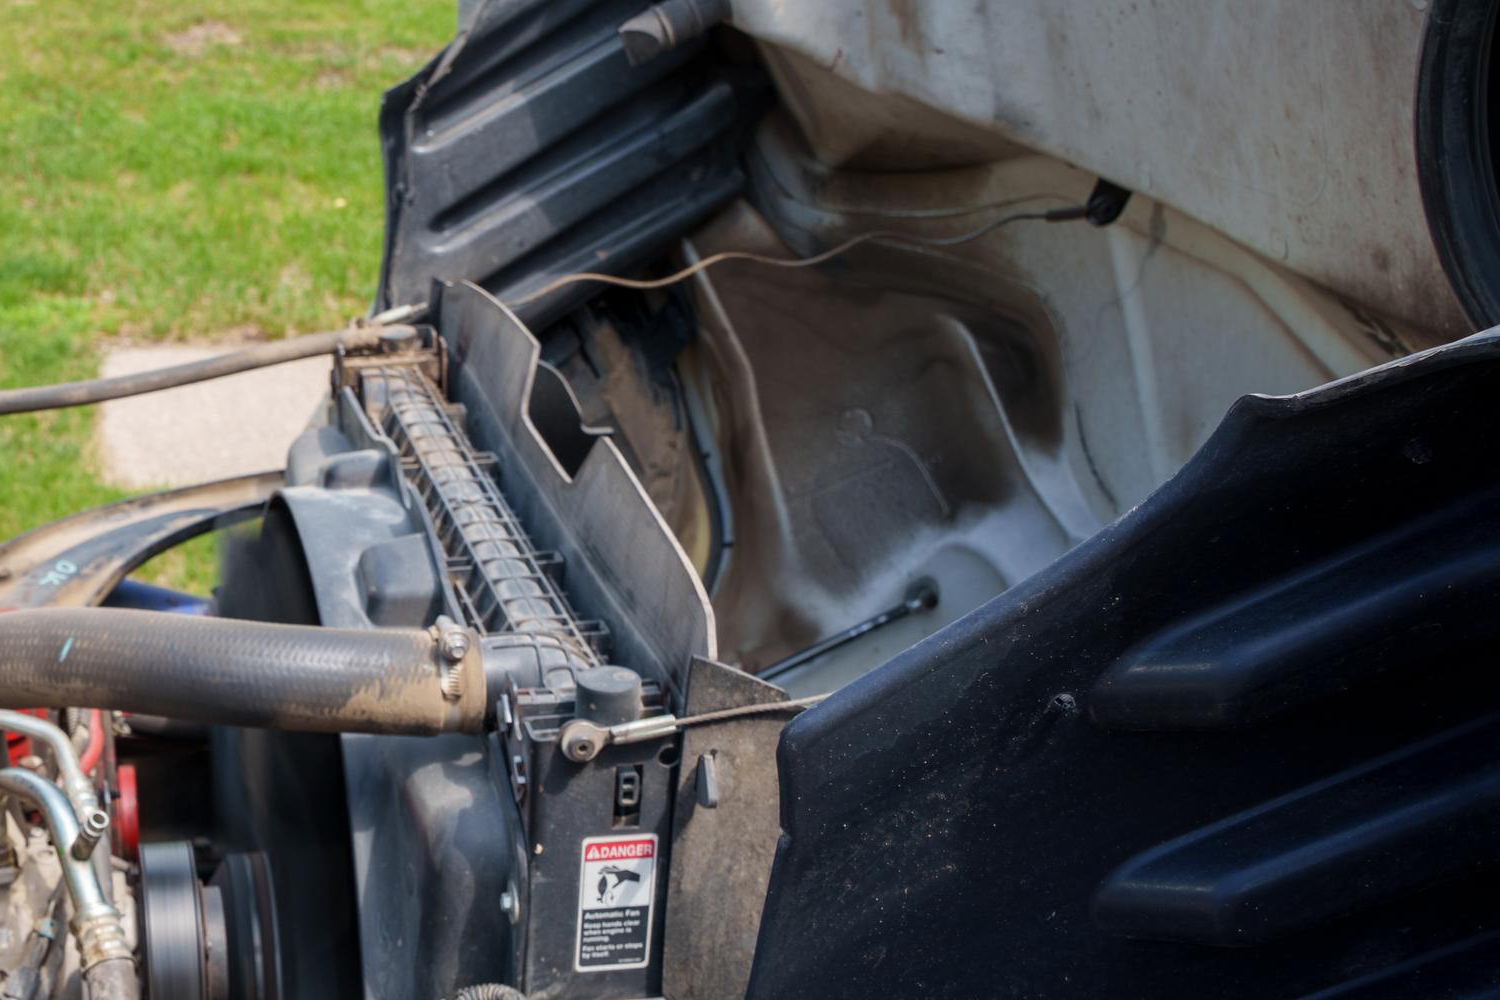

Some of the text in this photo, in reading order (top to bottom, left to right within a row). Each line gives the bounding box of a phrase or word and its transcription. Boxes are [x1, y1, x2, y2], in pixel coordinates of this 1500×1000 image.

[600, 844, 653, 859] DANGER
[584, 909, 640, 920] Automatic Fan
[583, 922, 601, 930] Keep
[602, 920, 622, 928] hands
[602, 928, 624, 936] engine
[595, 943, 615, 951] starts
[624, 942, 643, 950] stops
